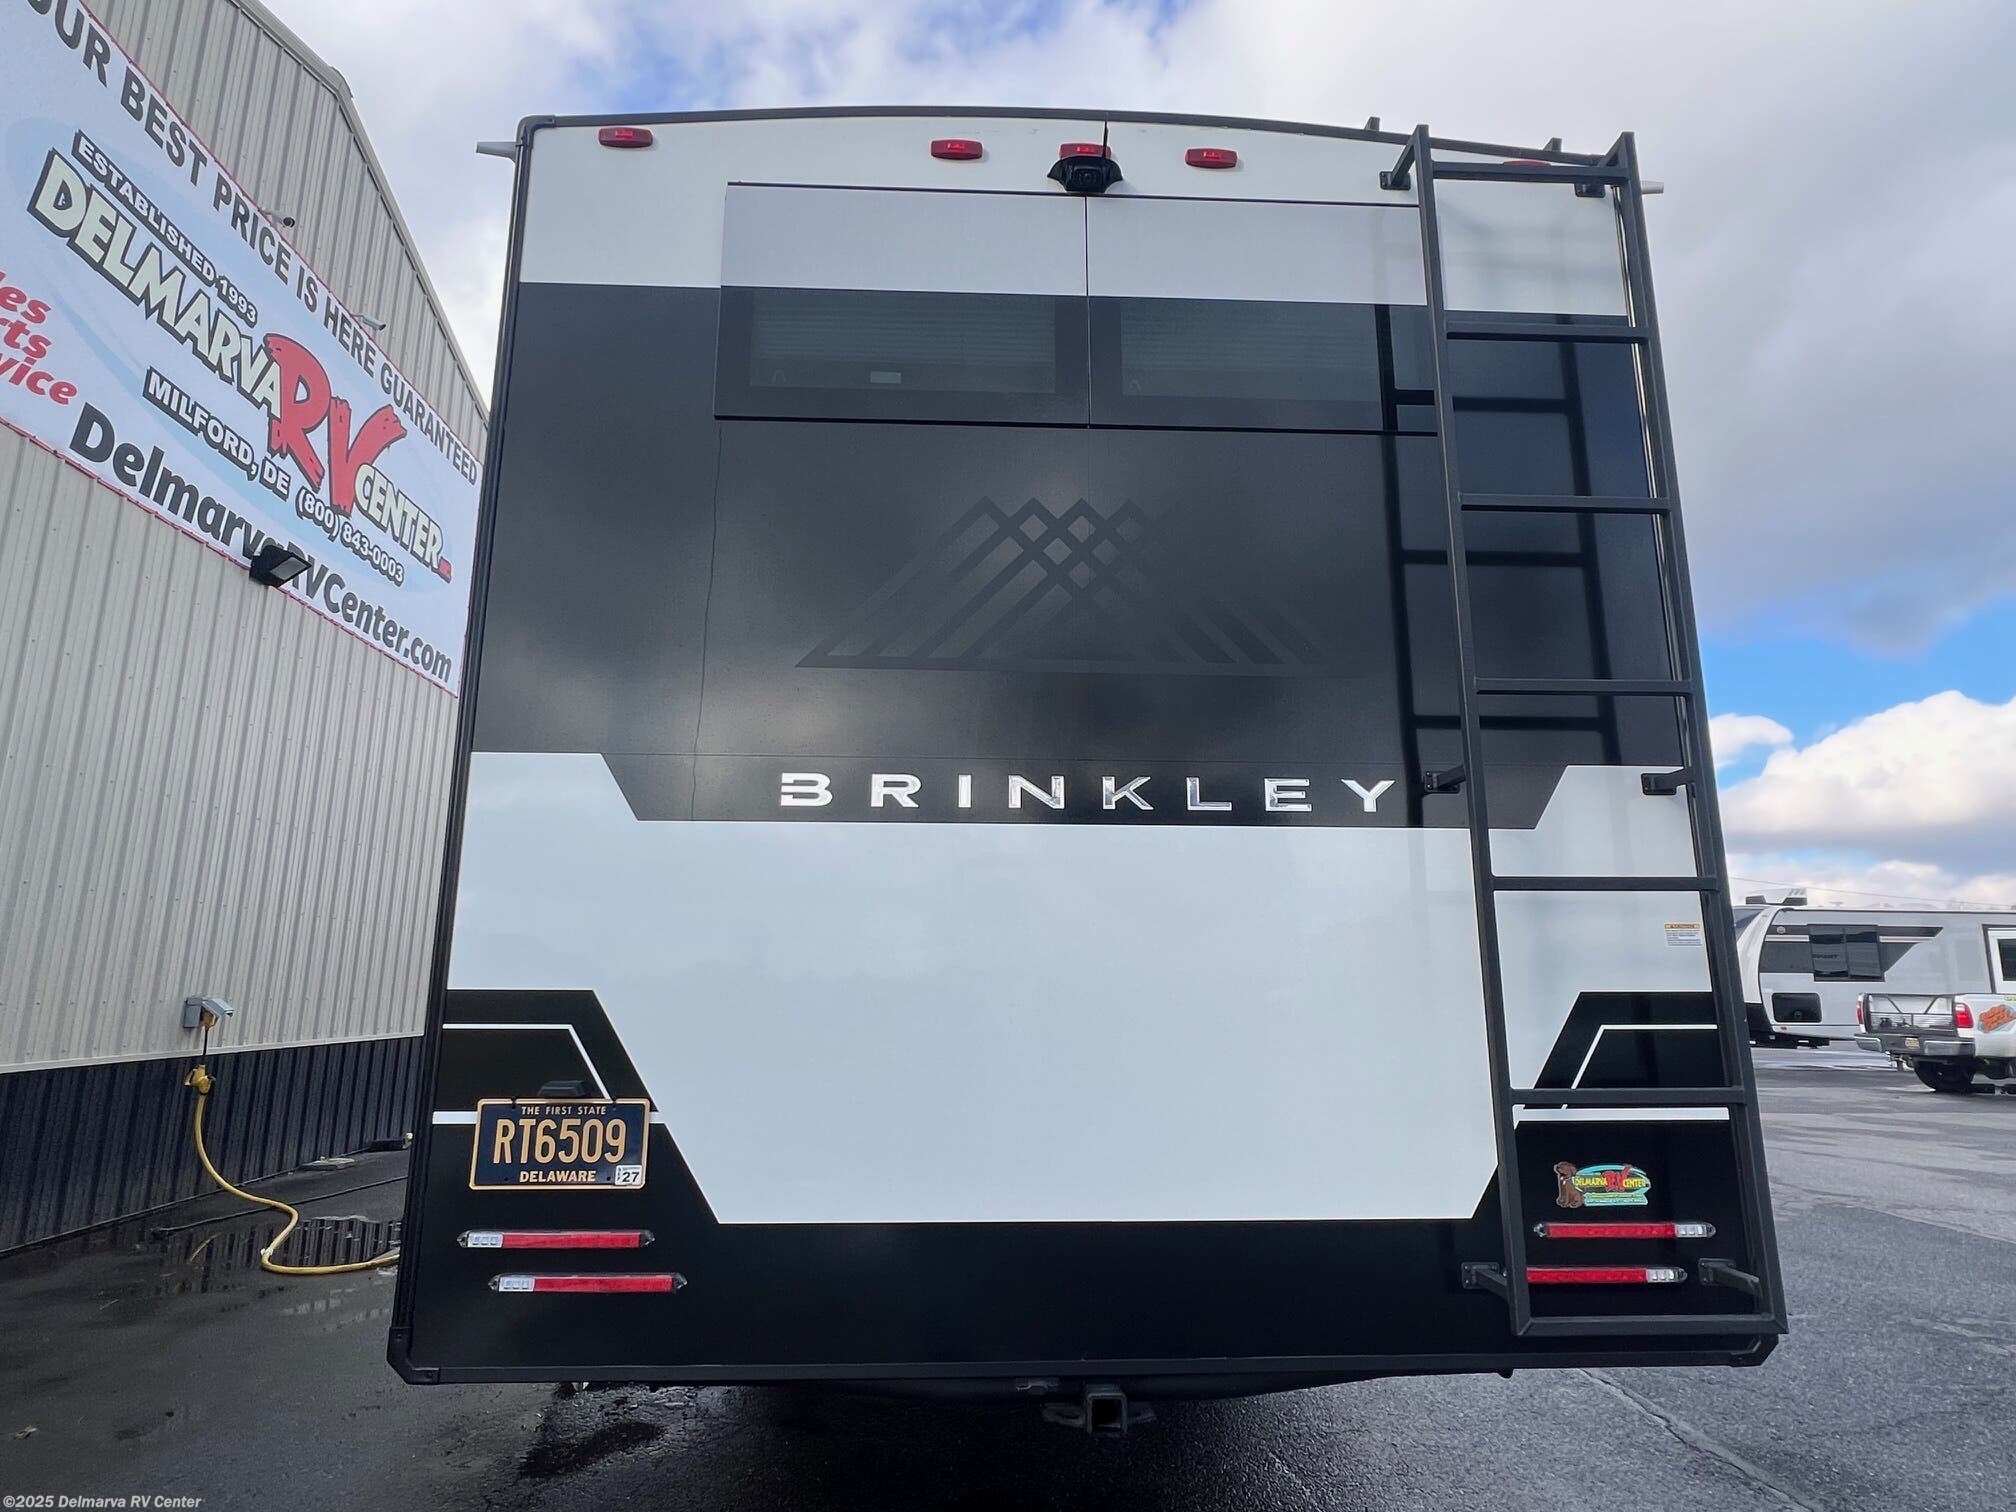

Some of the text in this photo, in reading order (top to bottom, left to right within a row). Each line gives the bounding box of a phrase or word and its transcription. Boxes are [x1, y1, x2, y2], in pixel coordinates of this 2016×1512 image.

[75, 132, 258, 324] ESTABLISHED 1993
[0, 271, 51, 324] es
[120, 66, 207, 186] BEST
[213, 172, 291, 285] PRICE
[296, 265, 318, 312] IS
[323, 296, 376, 378] HERE
[380, 361, 477, 485] GUARANTEED
[29, 150, 282, 420] DELMARVA
[264, 333, 407, 518] RV
[145, 368, 404, 586] MILFORD, DE (800) 843-0003
[69, 402, 452, 683] DelmarvVCenter.com
[780, 772, 1396, 812] BRINKLEY
[521, 1106, 607, 1116] THE FIRST STATE
[492, 1118, 627, 1164] RT6509
[519, 1170, 597, 1183] DELAWARE
[622, 1171, 640, 1183] 27
